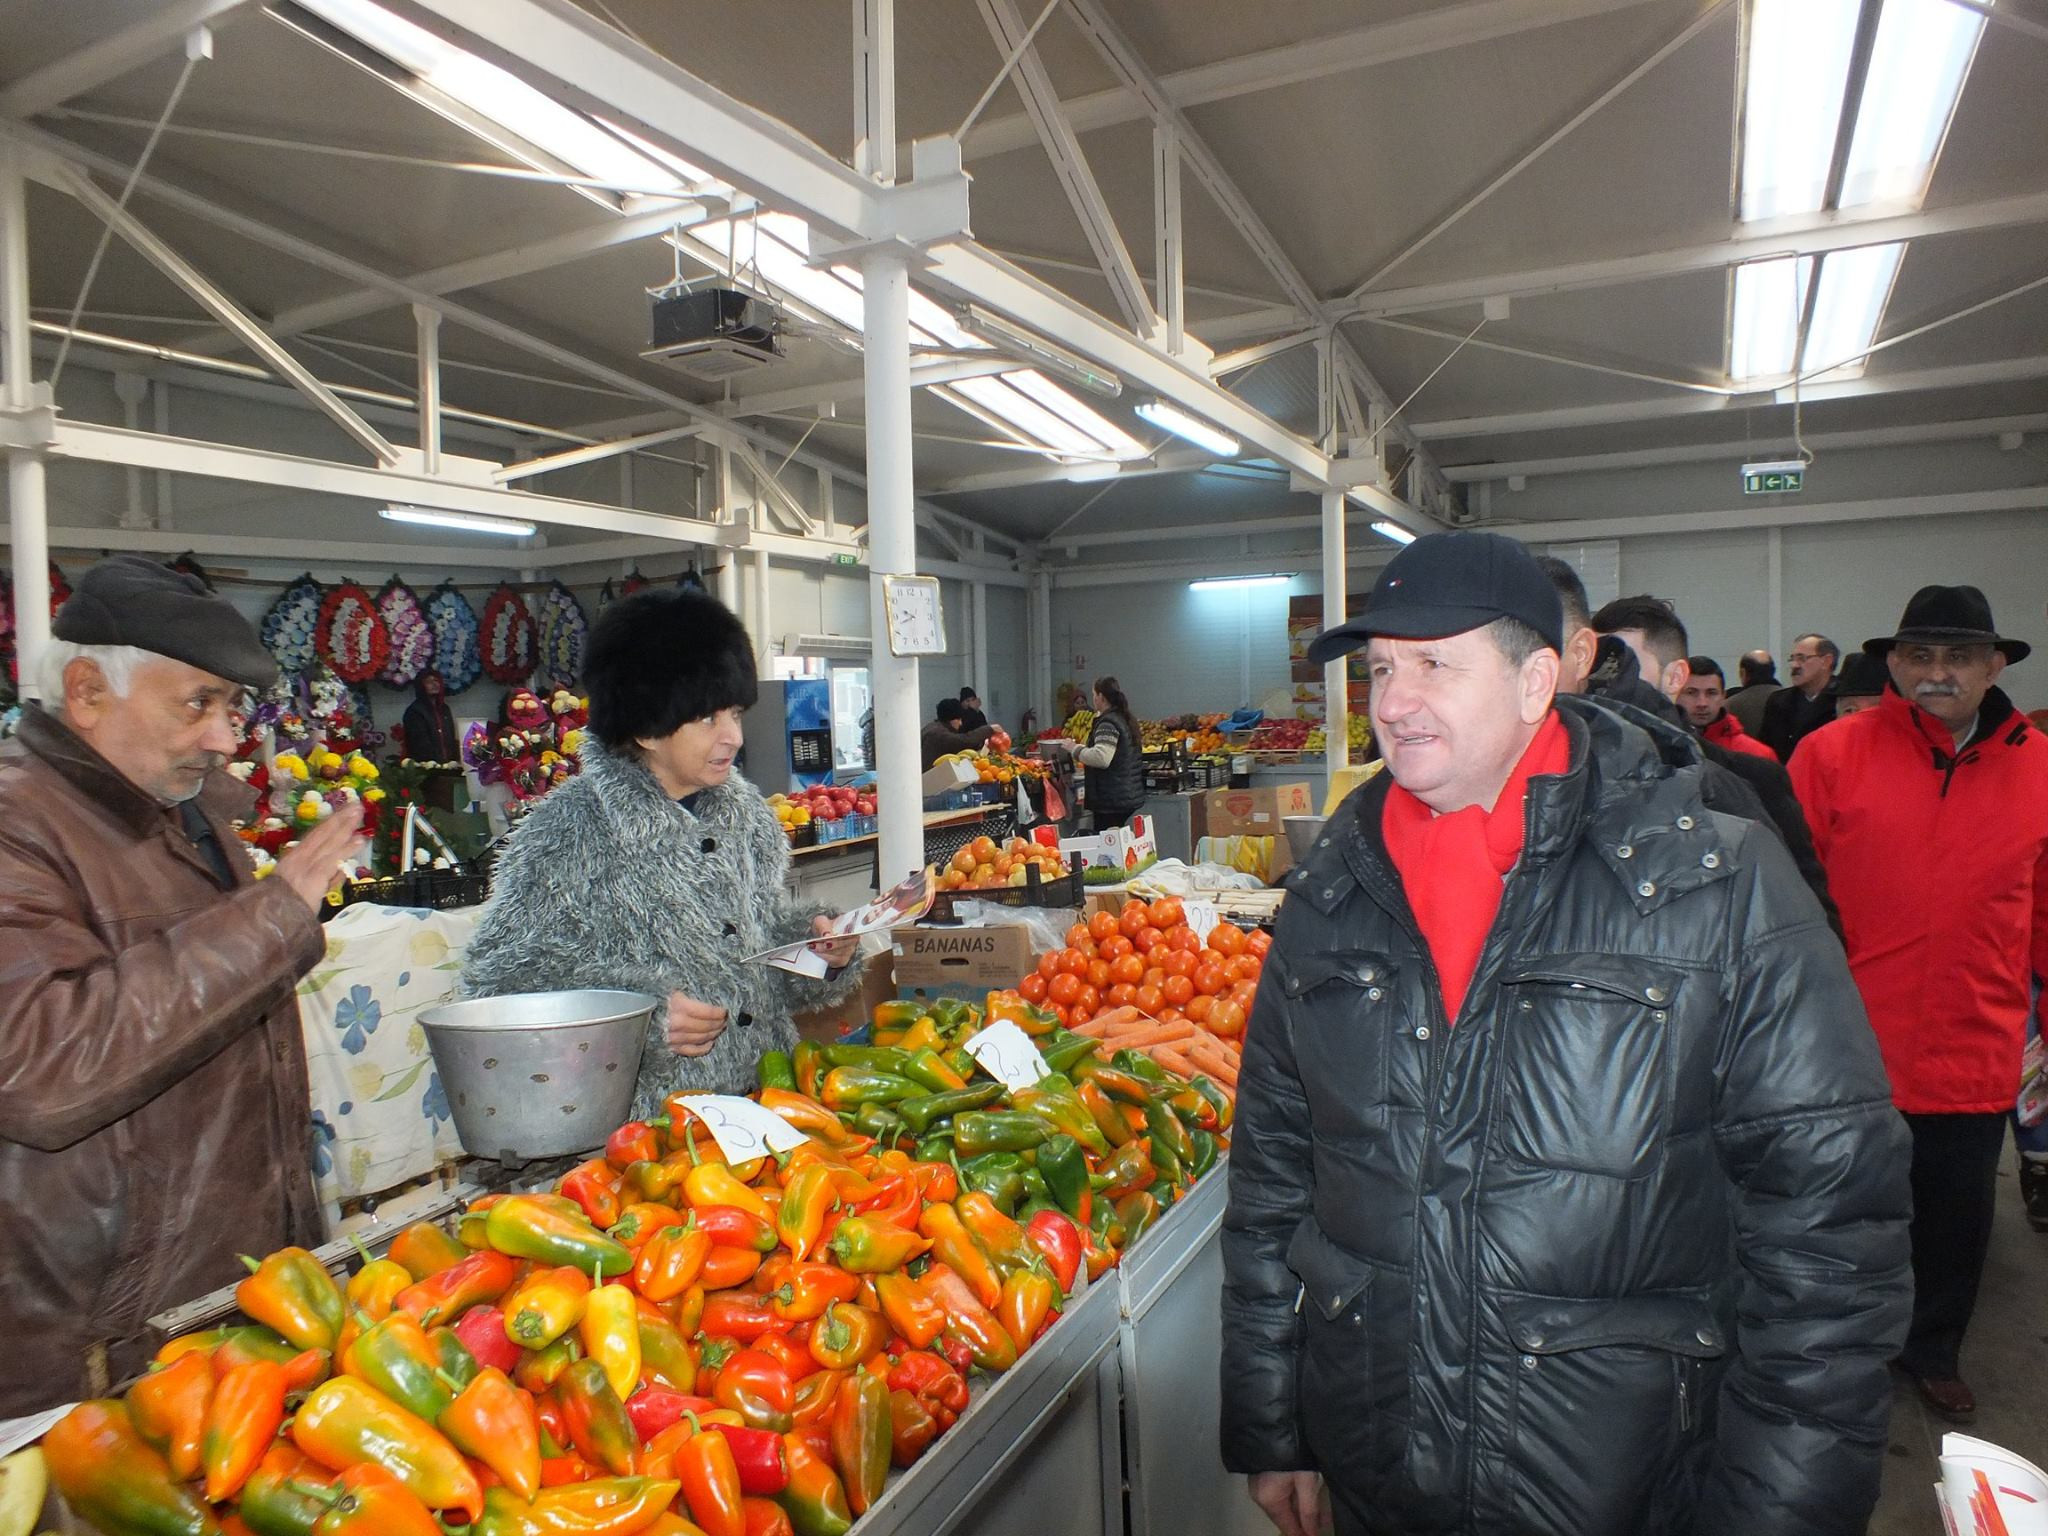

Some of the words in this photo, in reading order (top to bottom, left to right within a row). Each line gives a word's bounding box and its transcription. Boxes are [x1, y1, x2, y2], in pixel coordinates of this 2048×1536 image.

[840, 555, 854, 564] EXIT
[906, 588, 915, 597] 12
[927, 613, 933, 621] 3
[903, 637, 908, 646] 7
[912, 637, 919, 646] 6
[923, 636, 930, 645] 5
[914, 937, 995, 953] BANANAS
[980, 1041, 1020, 1081] 2
[701, 1105, 756, 1149] 3
